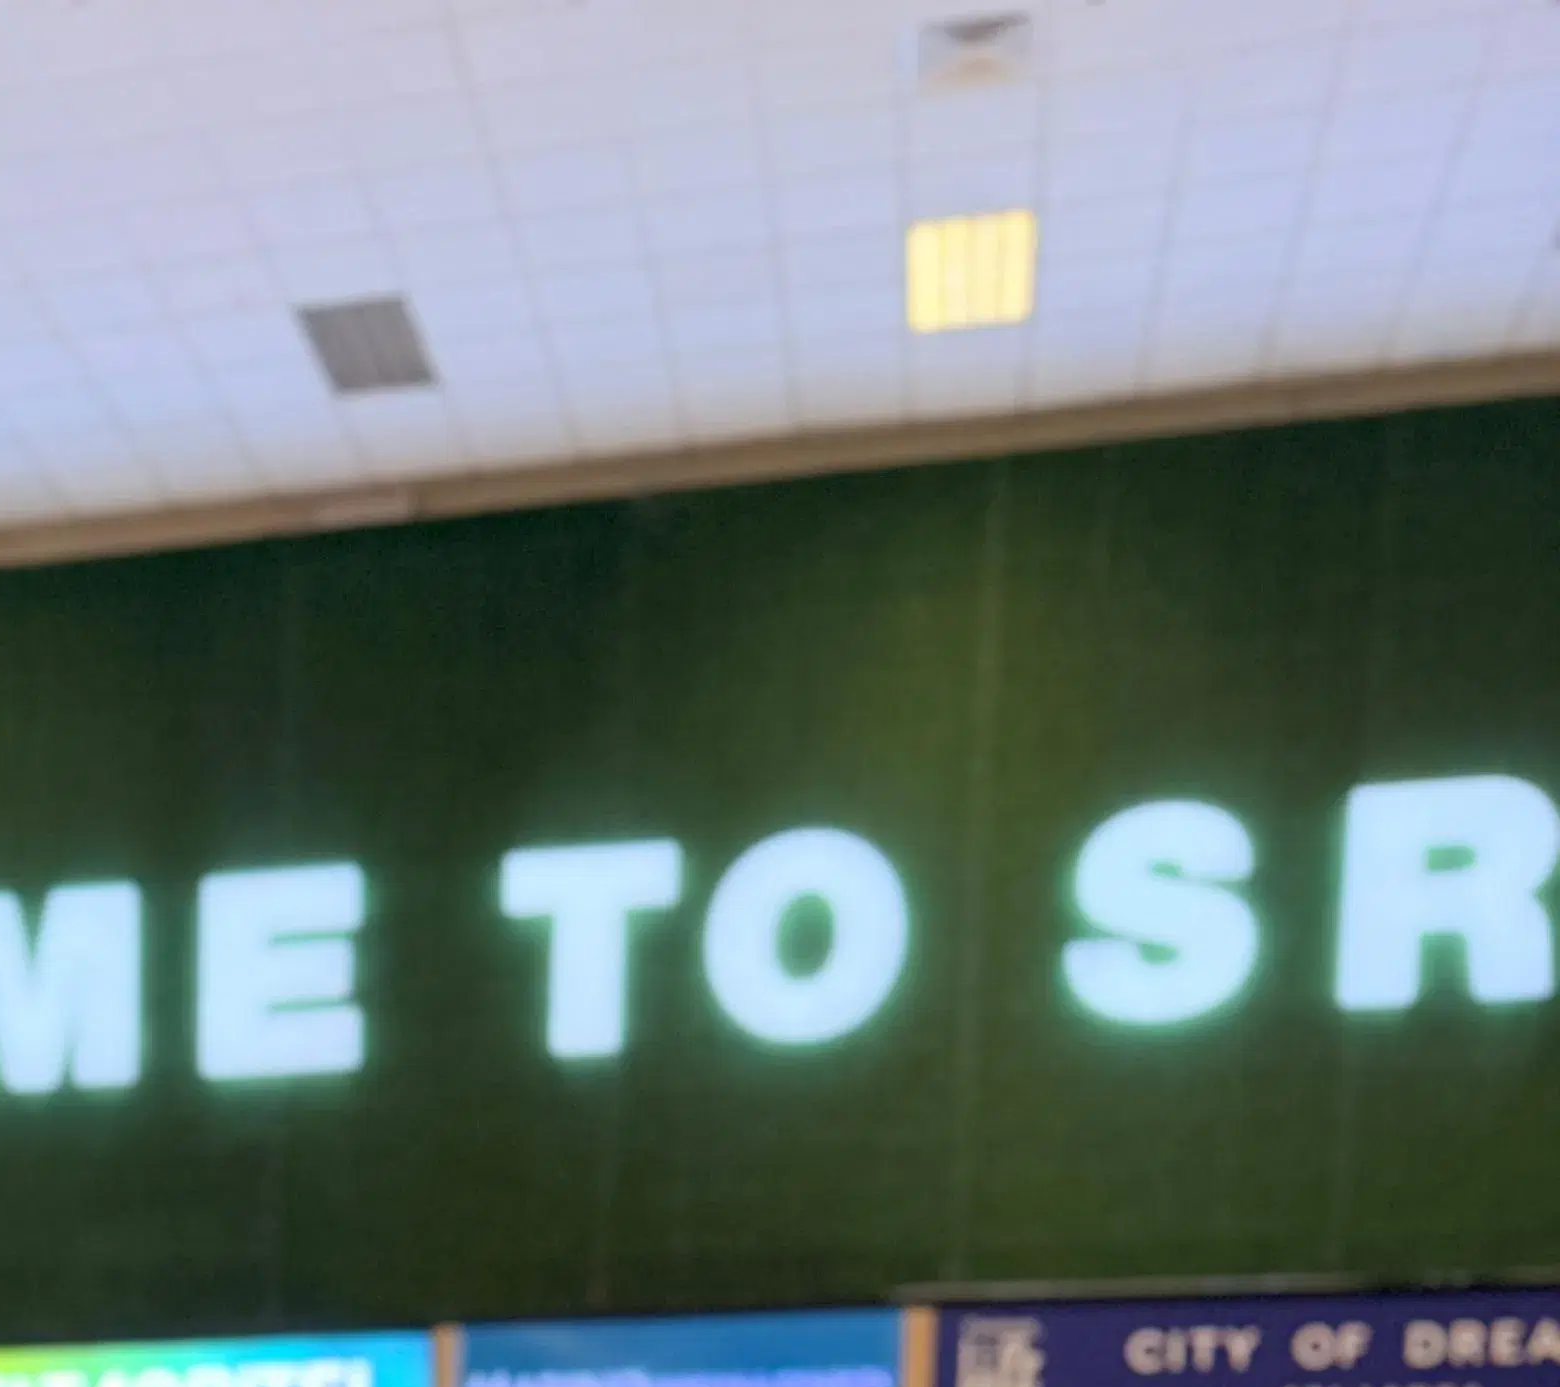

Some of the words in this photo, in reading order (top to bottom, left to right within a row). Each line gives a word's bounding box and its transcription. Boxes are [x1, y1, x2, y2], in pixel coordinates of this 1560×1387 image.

[500, 826, 908, 1057] TO
[1062, 774, 1559, 1024] SR
[1124, 1326, 1262, 1375] CITY
[1291, 1320, 1372, 1371] OF
